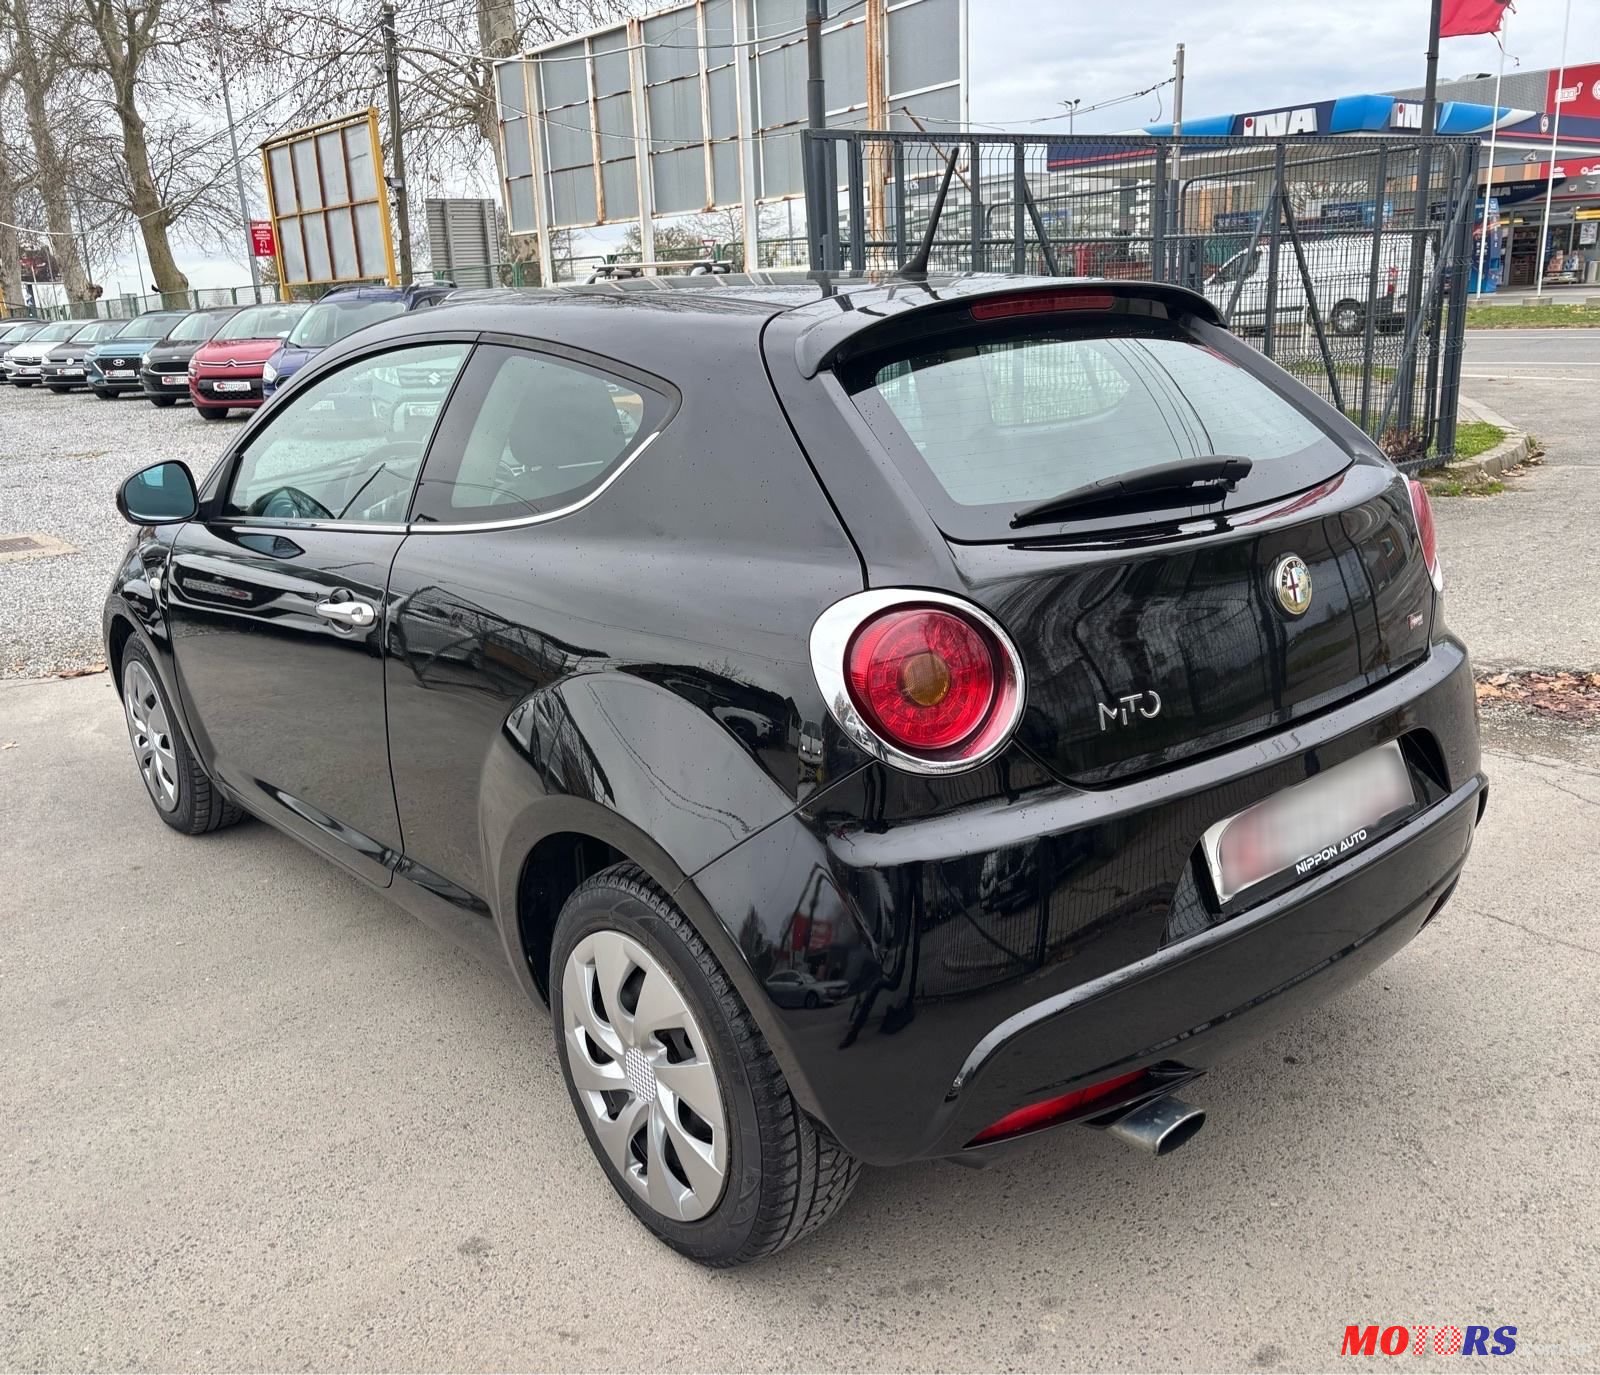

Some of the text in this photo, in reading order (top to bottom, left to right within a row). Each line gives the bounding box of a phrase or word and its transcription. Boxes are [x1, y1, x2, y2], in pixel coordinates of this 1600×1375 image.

[1243, 108, 1318, 136] INA
[1390, 103, 1437, 129] IN
[1295, 828, 1367, 875] NIPPON AUTO
